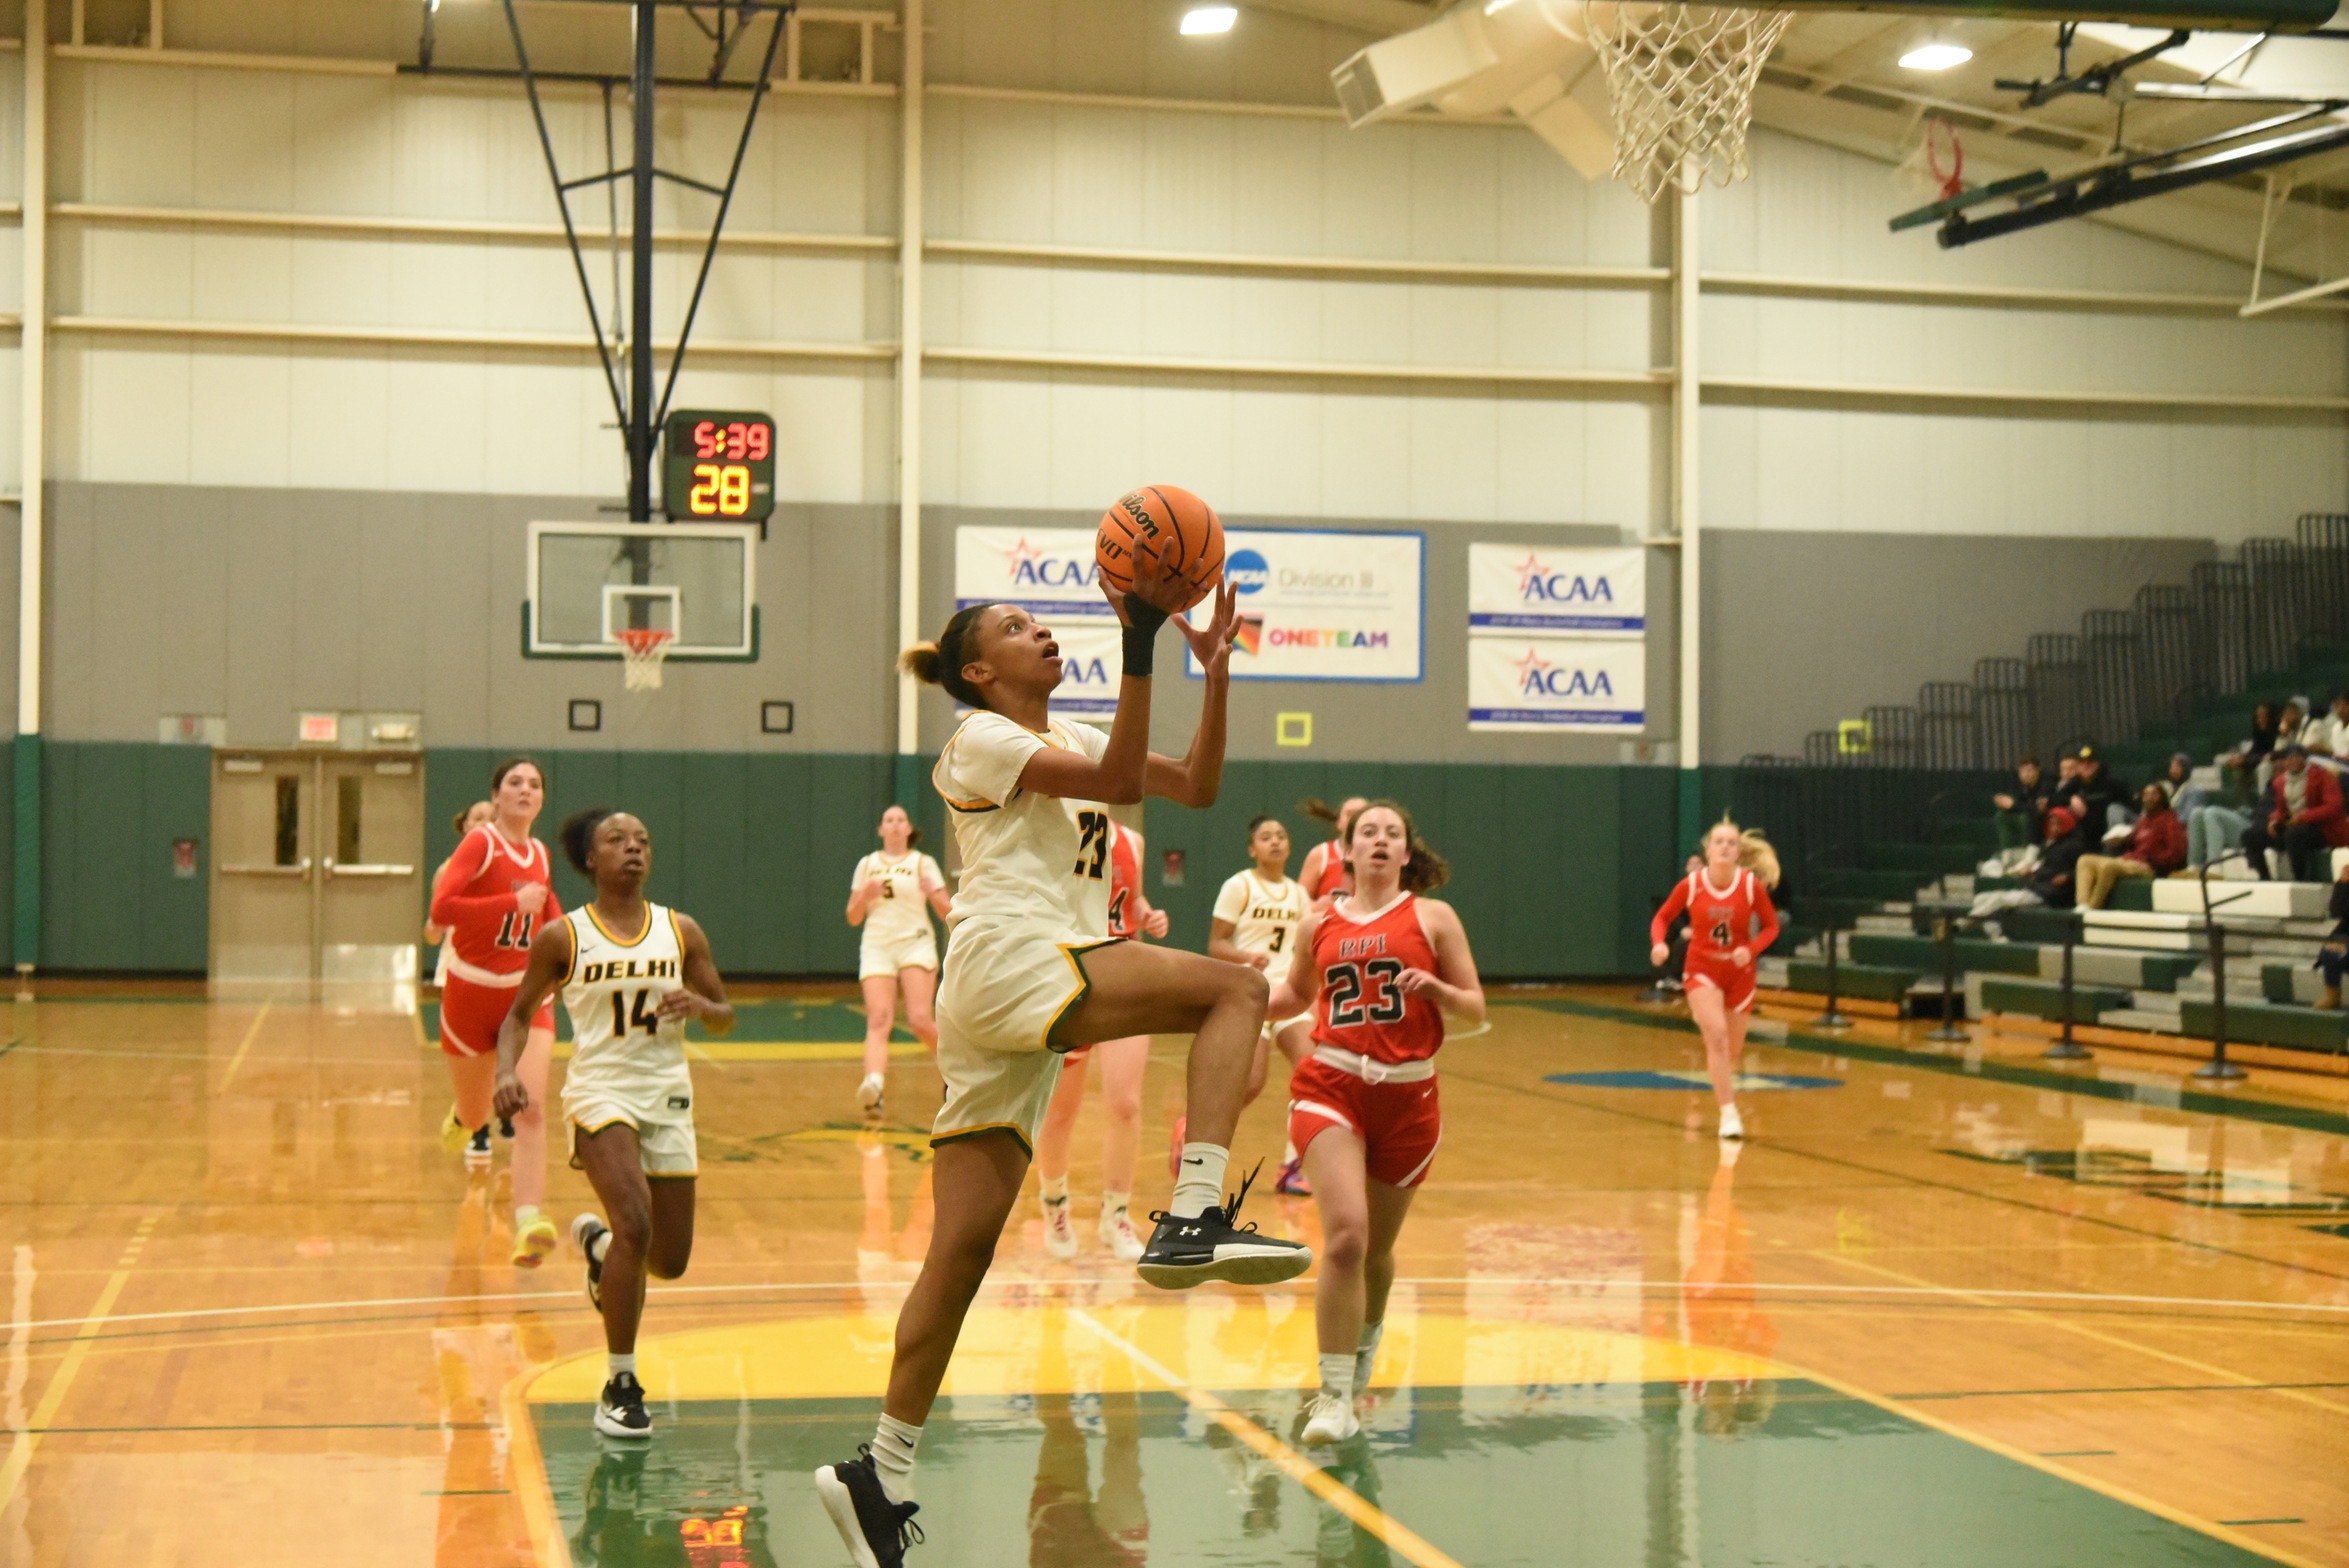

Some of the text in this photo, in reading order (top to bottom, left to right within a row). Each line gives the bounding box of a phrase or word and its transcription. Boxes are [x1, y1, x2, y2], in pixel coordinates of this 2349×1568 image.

[694, 421, 770, 460] 5:39
[690, 464, 750, 515] 28
[1524, 574, 1613, 602] ACAA
[1269, 628, 1389, 648] ONETEAM
[1524, 669, 1612, 696] ACAA
[1073, 808, 1108, 881] 23
[495, 911, 534, 951] 11
[1268, 926, 1286, 954] 3
[1710, 920, 1732, 947] 4
[1340, 933, 1387, 960] RPI
[583, 960, 676, 986] DELHI
[1325, 957, 1406, 1029] 23
[611, 987, 659, 1037] 14
